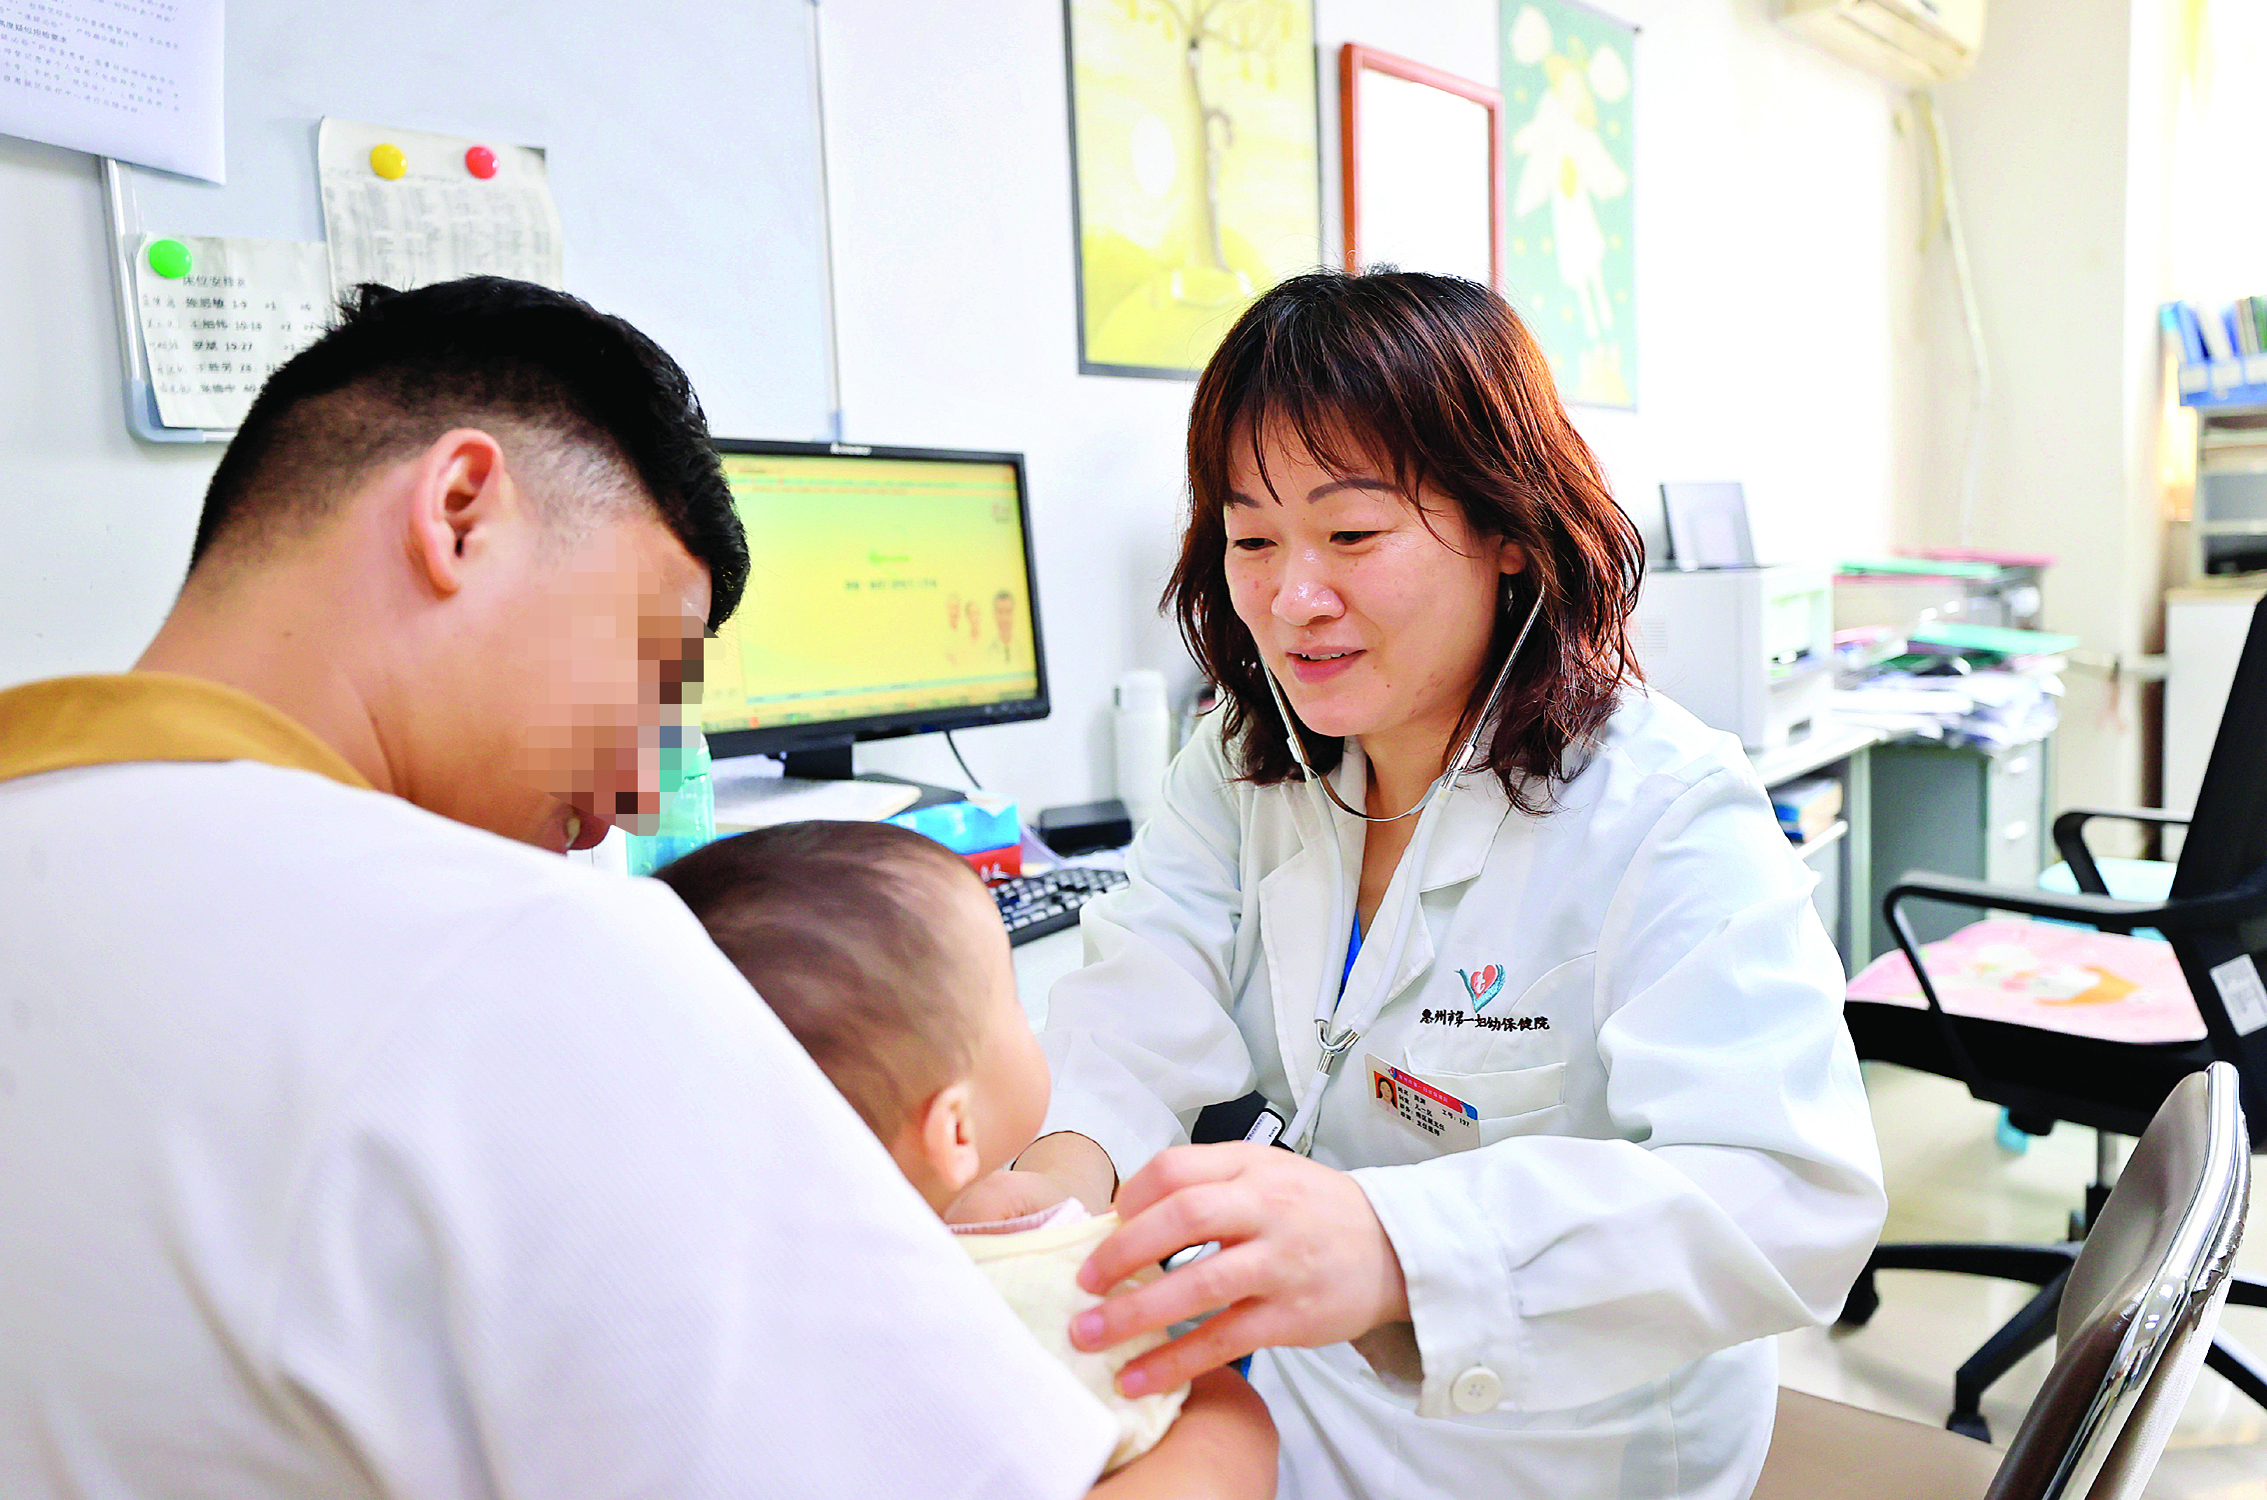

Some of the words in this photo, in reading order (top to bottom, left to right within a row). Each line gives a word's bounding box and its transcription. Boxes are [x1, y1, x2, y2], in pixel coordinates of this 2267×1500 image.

[1420, 1008, 1550, 1032] 惠州市第一妇幼保健院
